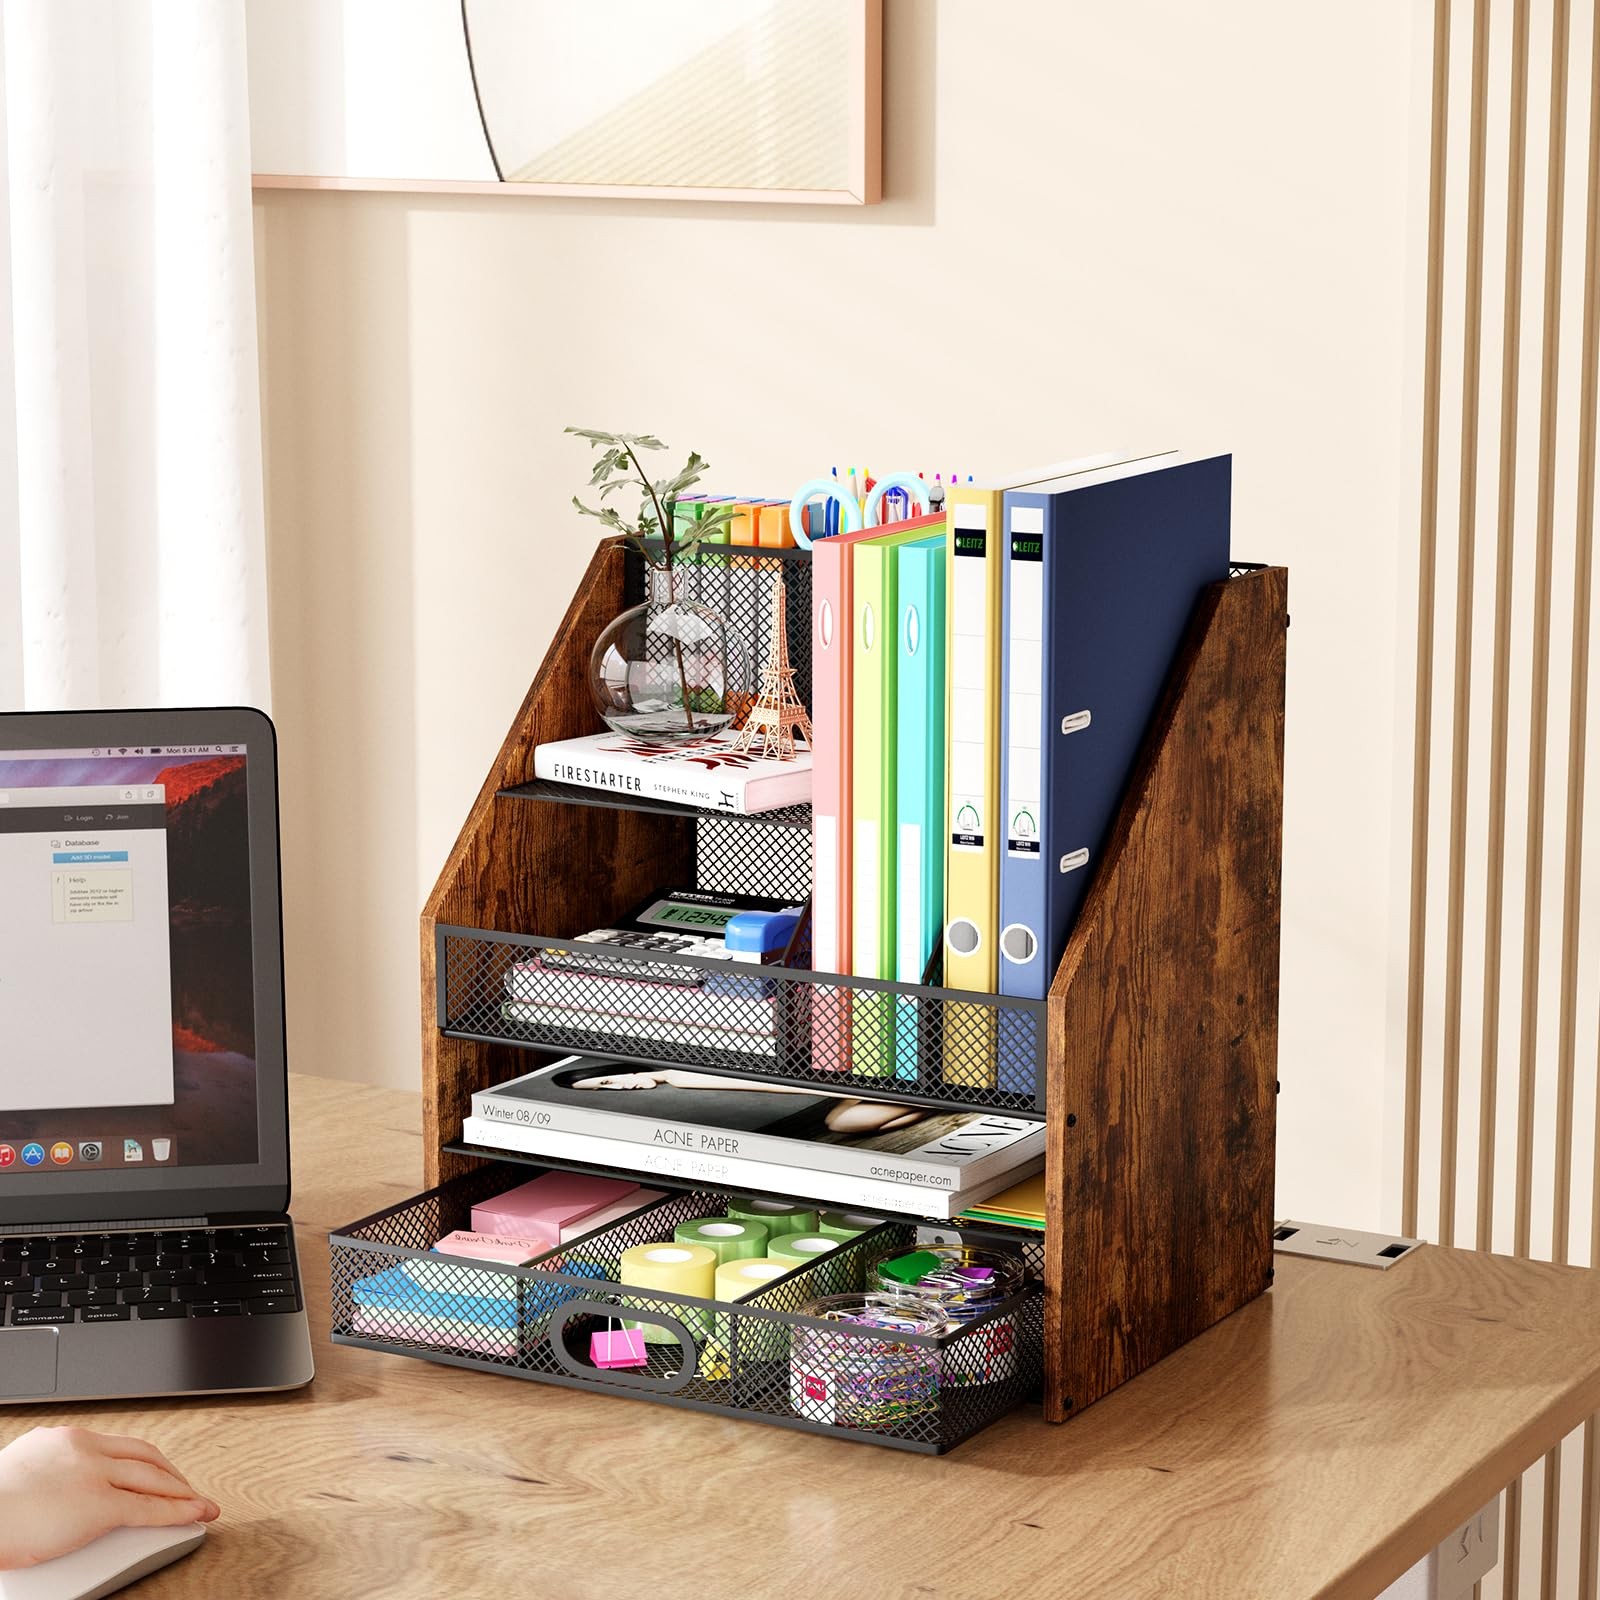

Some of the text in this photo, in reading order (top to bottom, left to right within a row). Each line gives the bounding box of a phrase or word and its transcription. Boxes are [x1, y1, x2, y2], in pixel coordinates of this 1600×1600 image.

[962, 538, 984, 549] LEITZ
[1019, 541, 1040, 553] LEITZ
[554, 763, 642, 792] FIRESTARTER
[653, 784, 711, 800] STEPHEN KING
[482, 1104, 551, 1125] Winter 08/09
[653, 1128, 739, 1154] ACNE PAPER
[923, 1116, 1033, 1163] ACNE
[870, 1165, 952, 1186] acnepaper.com
